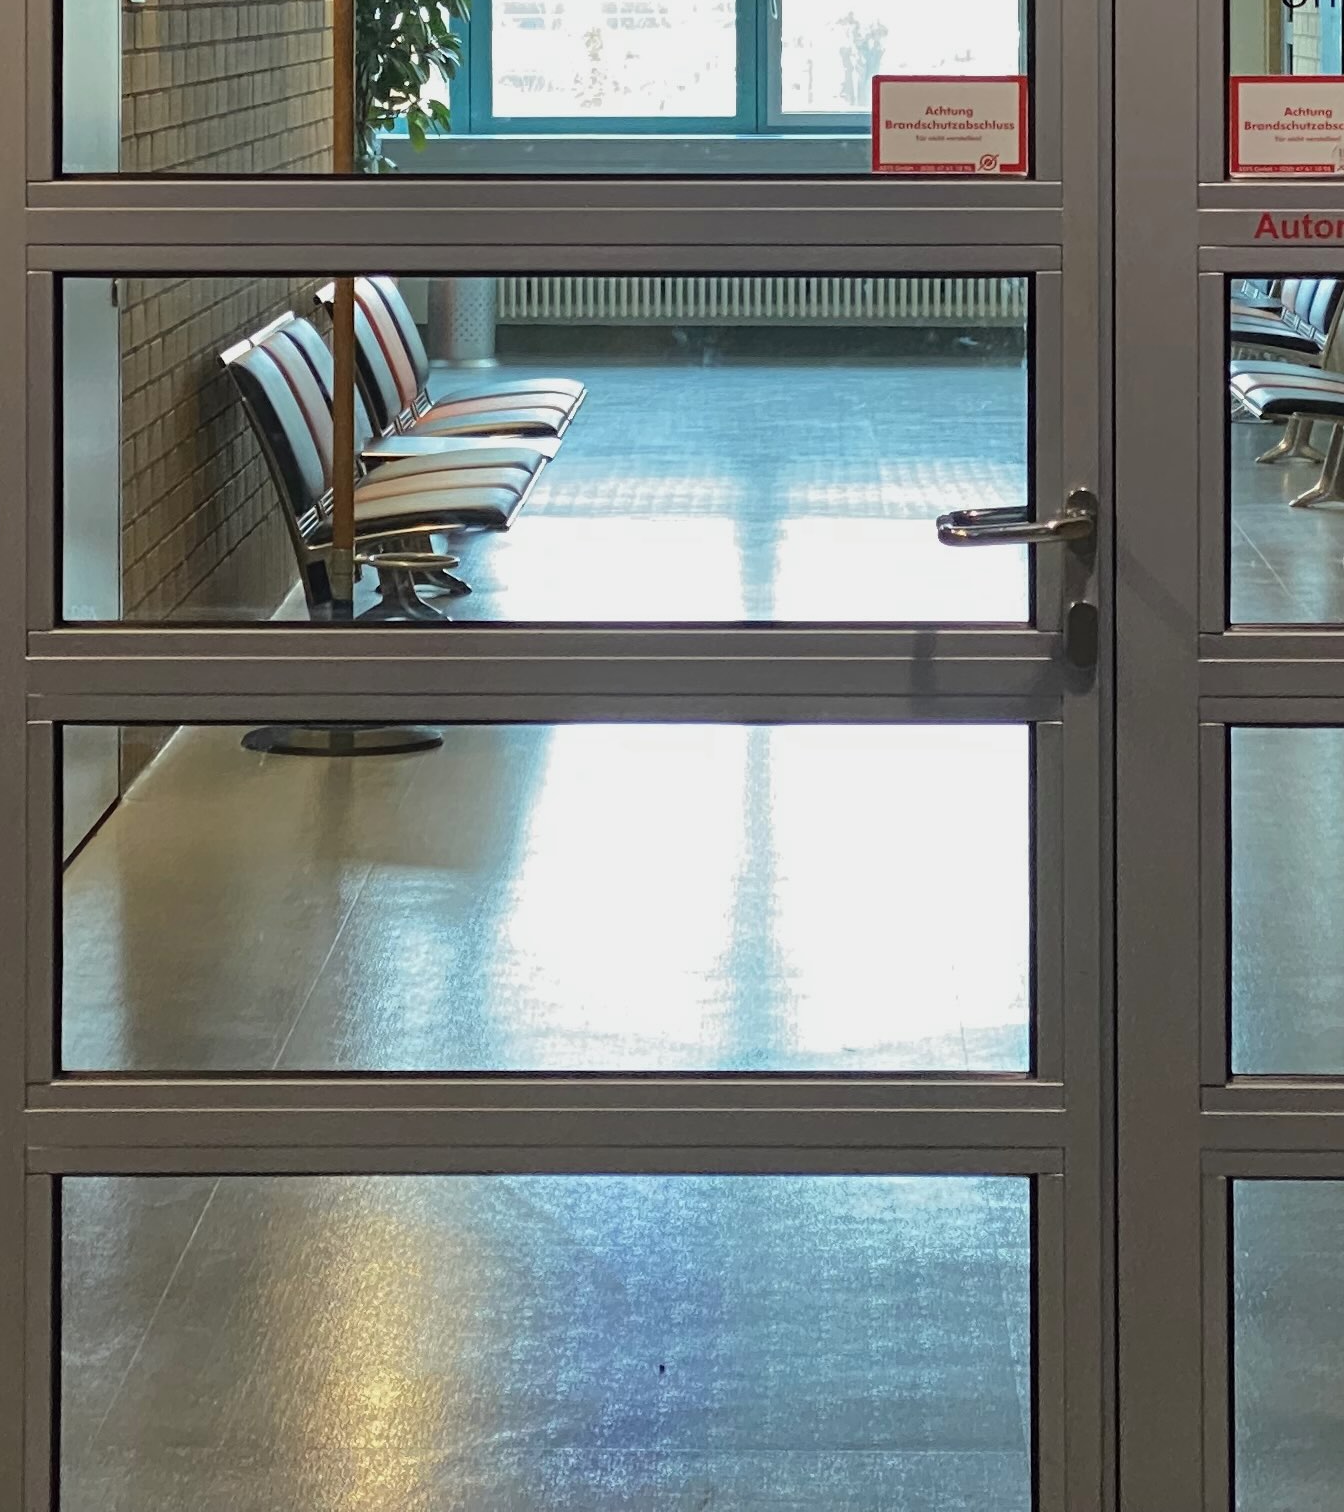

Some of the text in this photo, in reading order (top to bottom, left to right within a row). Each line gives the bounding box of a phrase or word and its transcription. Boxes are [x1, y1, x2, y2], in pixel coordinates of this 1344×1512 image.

[925, 106, 974, 117] Achtung
[1284, 107, 1333, 118] Achtung
[885, 120, 1015, 130] Brandschutzabschluss
